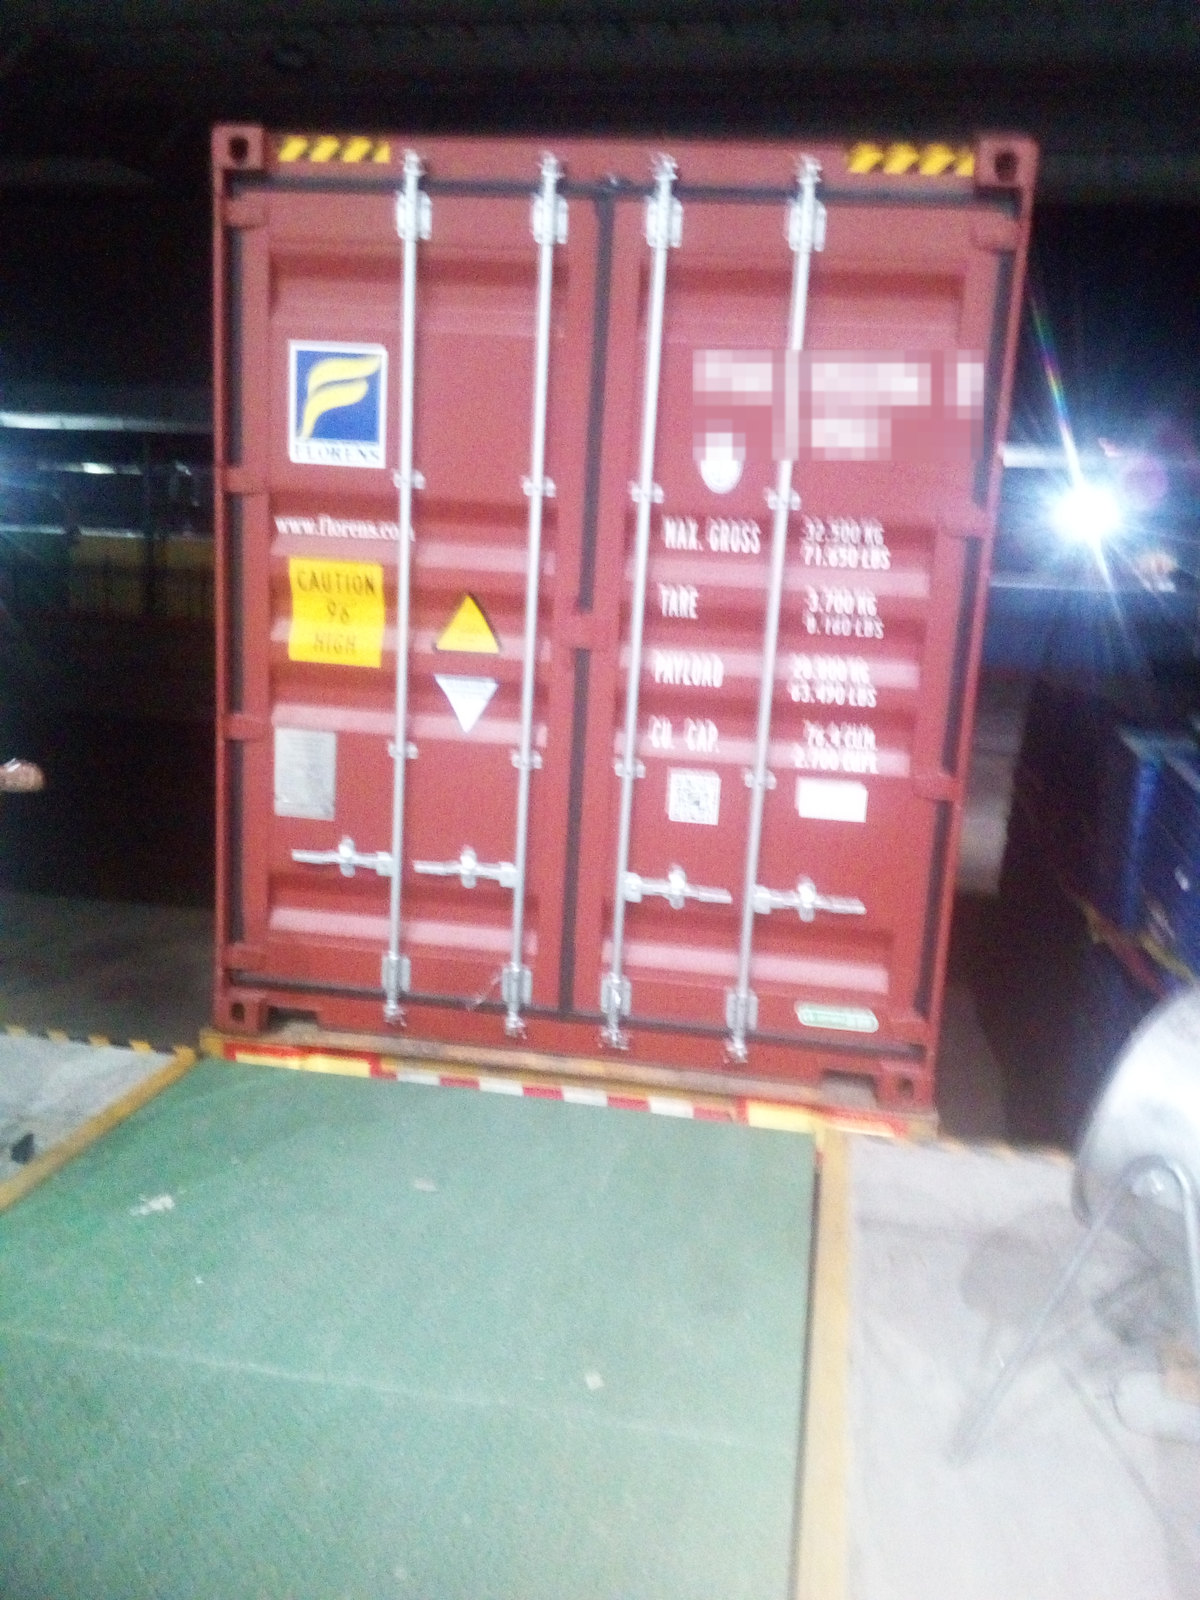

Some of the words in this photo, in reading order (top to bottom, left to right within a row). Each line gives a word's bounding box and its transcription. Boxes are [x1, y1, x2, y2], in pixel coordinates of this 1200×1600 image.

[707, 517, 761, 554] GROSS
[297, 570, 376, 596] CAUTION
[658, 583, 698, 619] TARE
[313, 632, 357, 655] HIGH
[653, 651, 724, 688] PAYLOAD
